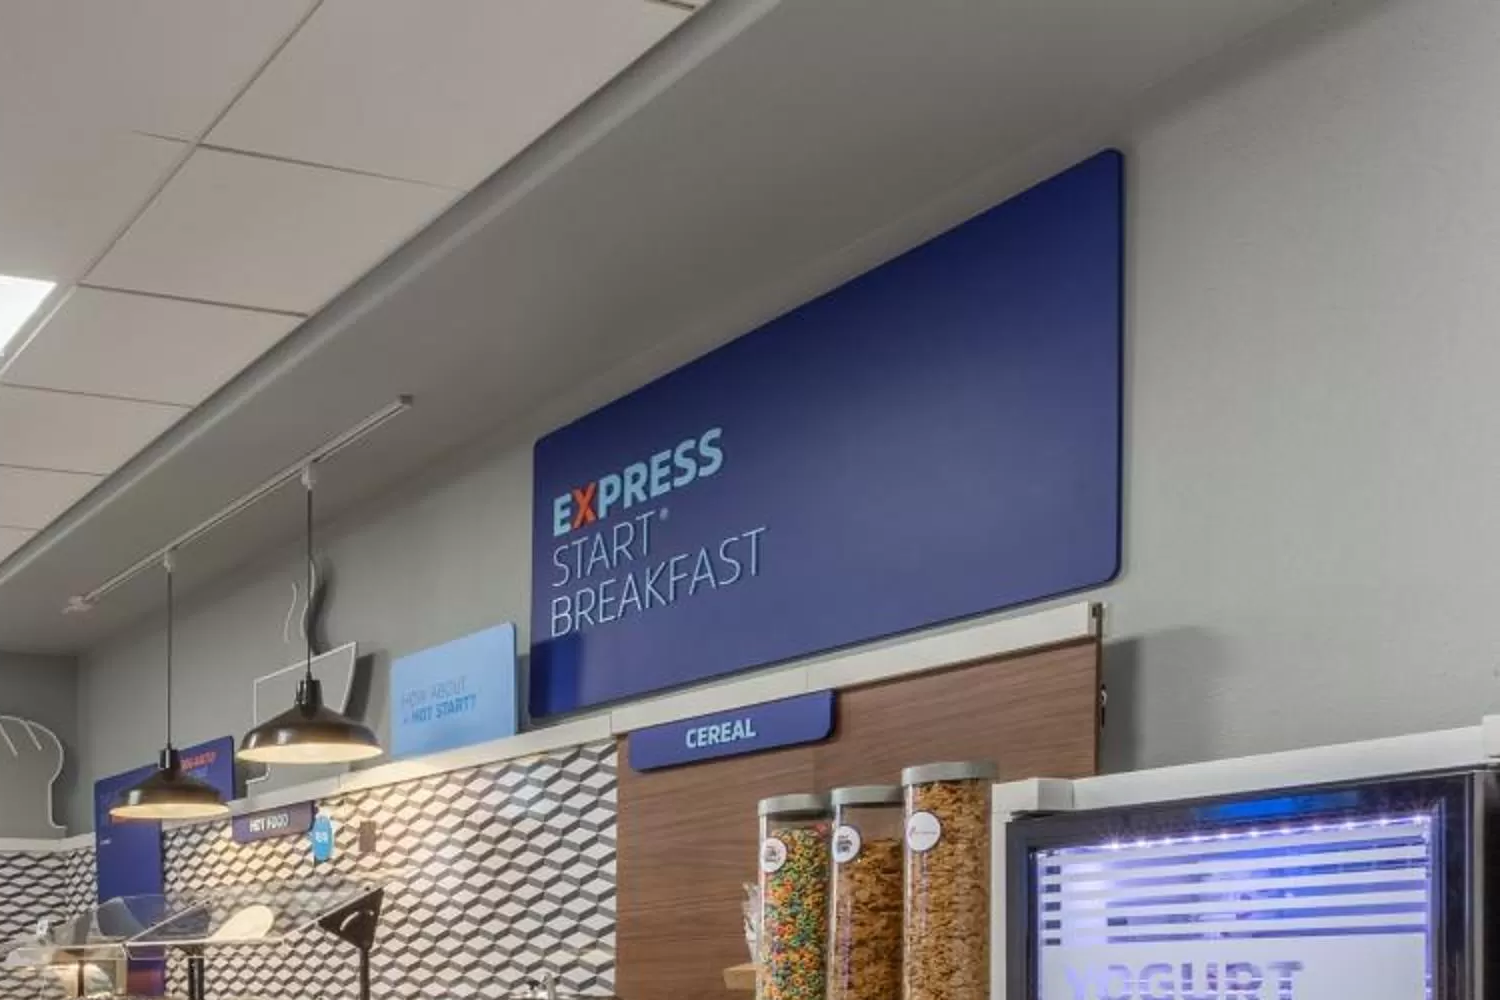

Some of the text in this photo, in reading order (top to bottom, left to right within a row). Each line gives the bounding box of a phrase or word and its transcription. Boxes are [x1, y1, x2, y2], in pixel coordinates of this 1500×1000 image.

[553, 427, 723, 536] EXPRESS
[551, 526, 766, 637] BREAKFAST
[686, 717, 757, 748] CEREAL
[249, 812, 290, 833] HOT FOOD
